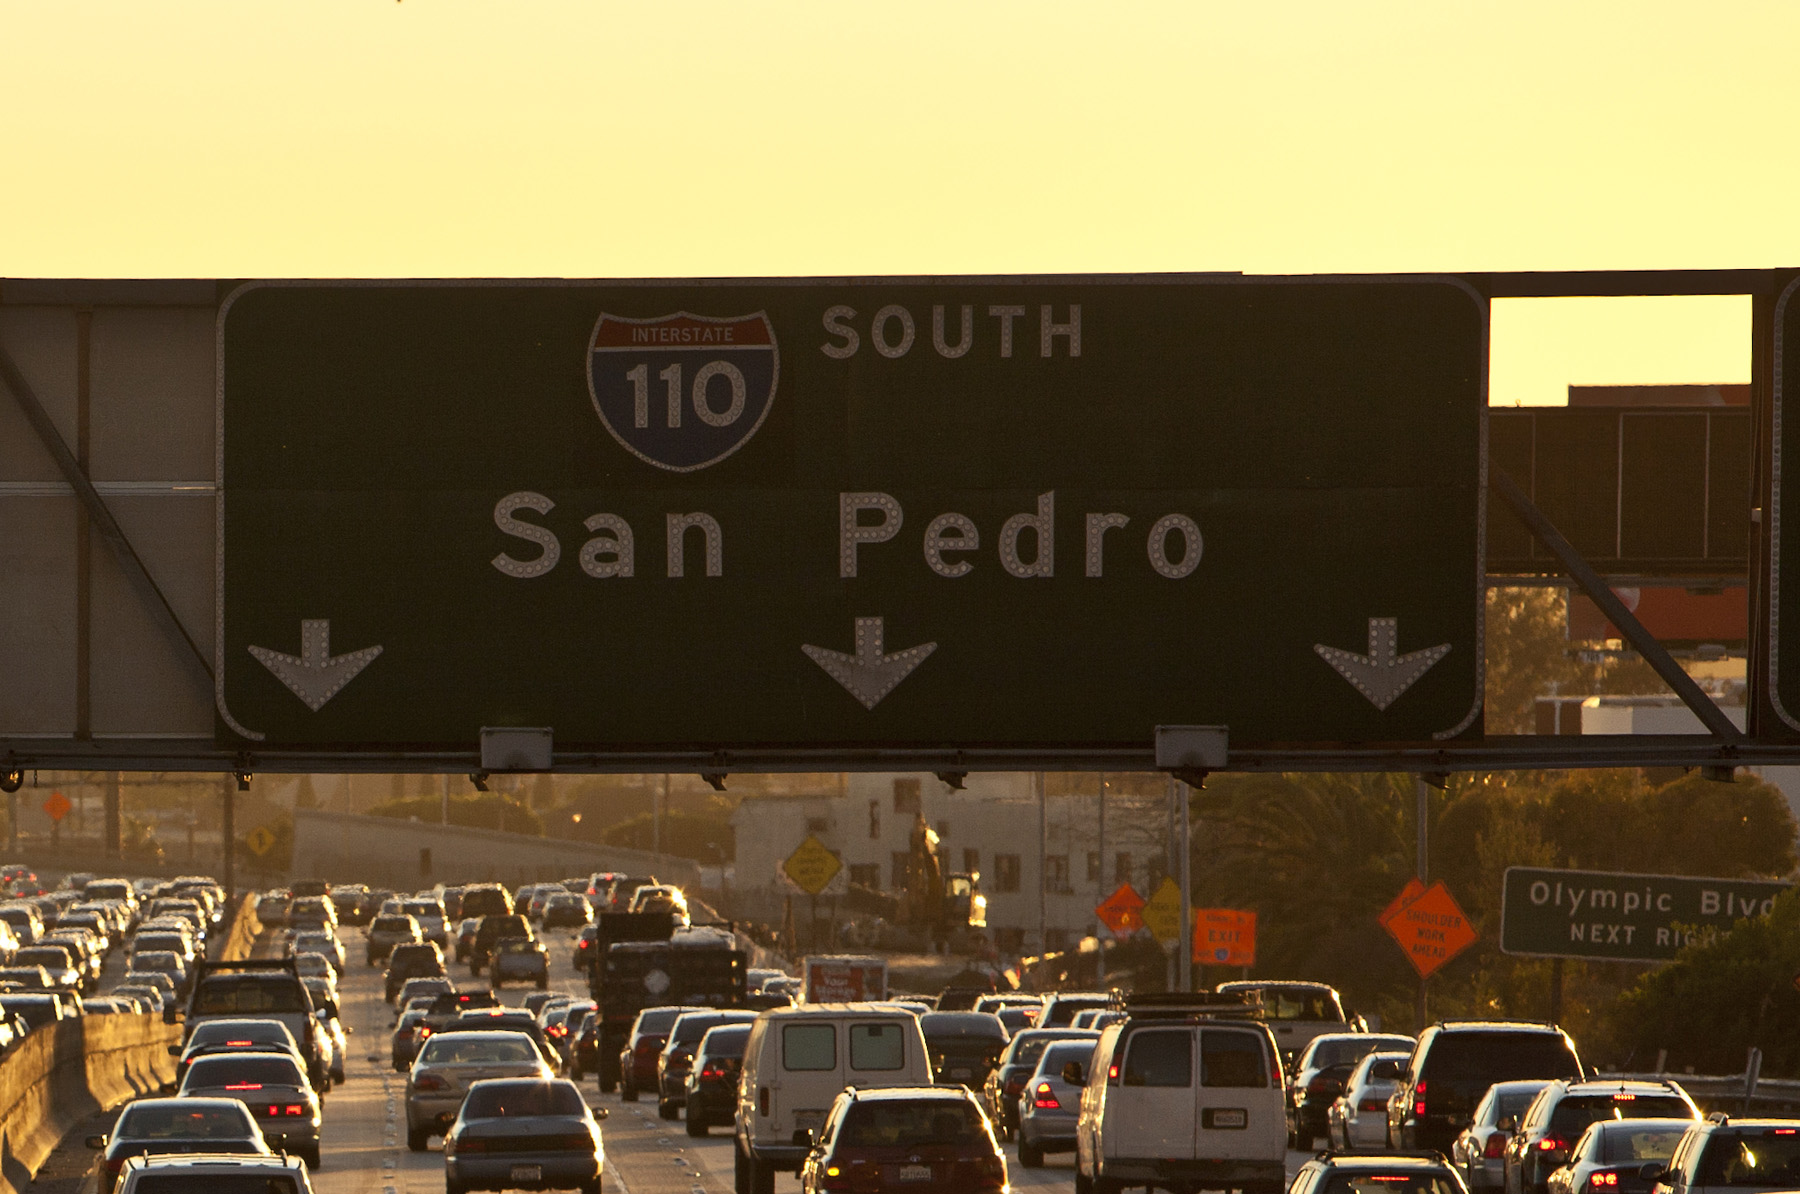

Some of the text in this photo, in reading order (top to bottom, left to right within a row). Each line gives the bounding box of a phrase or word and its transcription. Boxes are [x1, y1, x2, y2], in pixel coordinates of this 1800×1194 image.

[632, 327, 734, 342] INTERSTATE
[820, 303, 1083, 359] SOUTH
[626, 360, 747, 428] 110
[490, 489, 1204, 579] San Pedro
[1529, 880, 1672, 916] Olympic
[1406, 909, 1461, 929] SHOULDER
[1208, 929, 1241, 943] EXIT
[1417, 928, 1446, 943] WORK
[1570, 923, 1636, 945] NEXT
[1412, 944, 1447, 959] AHEAD
